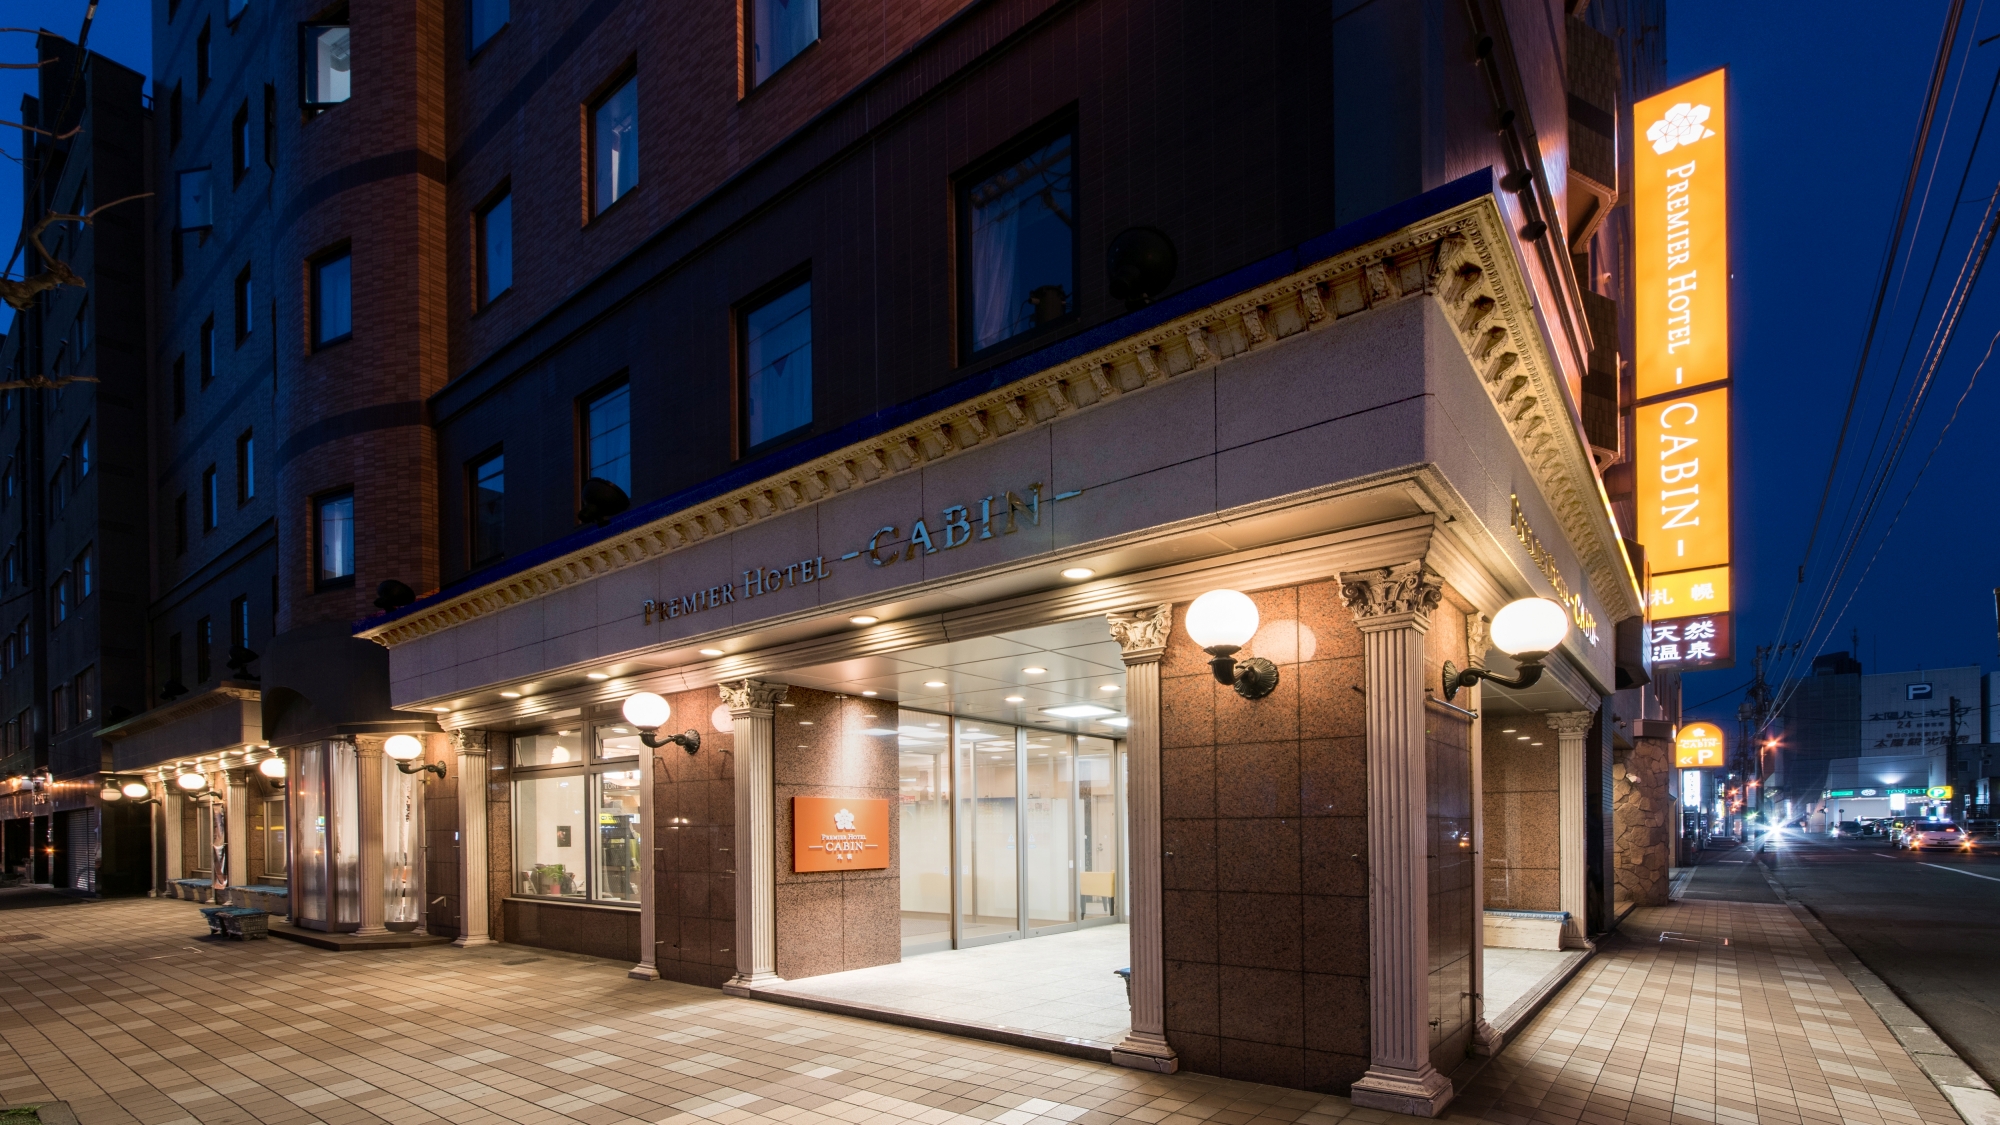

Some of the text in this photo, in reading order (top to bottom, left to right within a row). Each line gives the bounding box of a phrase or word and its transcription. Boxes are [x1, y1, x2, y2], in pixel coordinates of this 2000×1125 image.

[1666, 160, 1697, 355] PREMIER HOTEL
[643, 582, 735, 626] PREMIER
[742, 555, 832, 599] HOTEL
[1650, 620, 1716, 643] 天然
[1651, 640, 1717, 662] 温泉
[1907, 684, 1931, 700] P
[1698, 749, 1713, 764] P
[1885, 788, 1927, 796] TOYOPET
[1934, 788, 1945, 797] P
